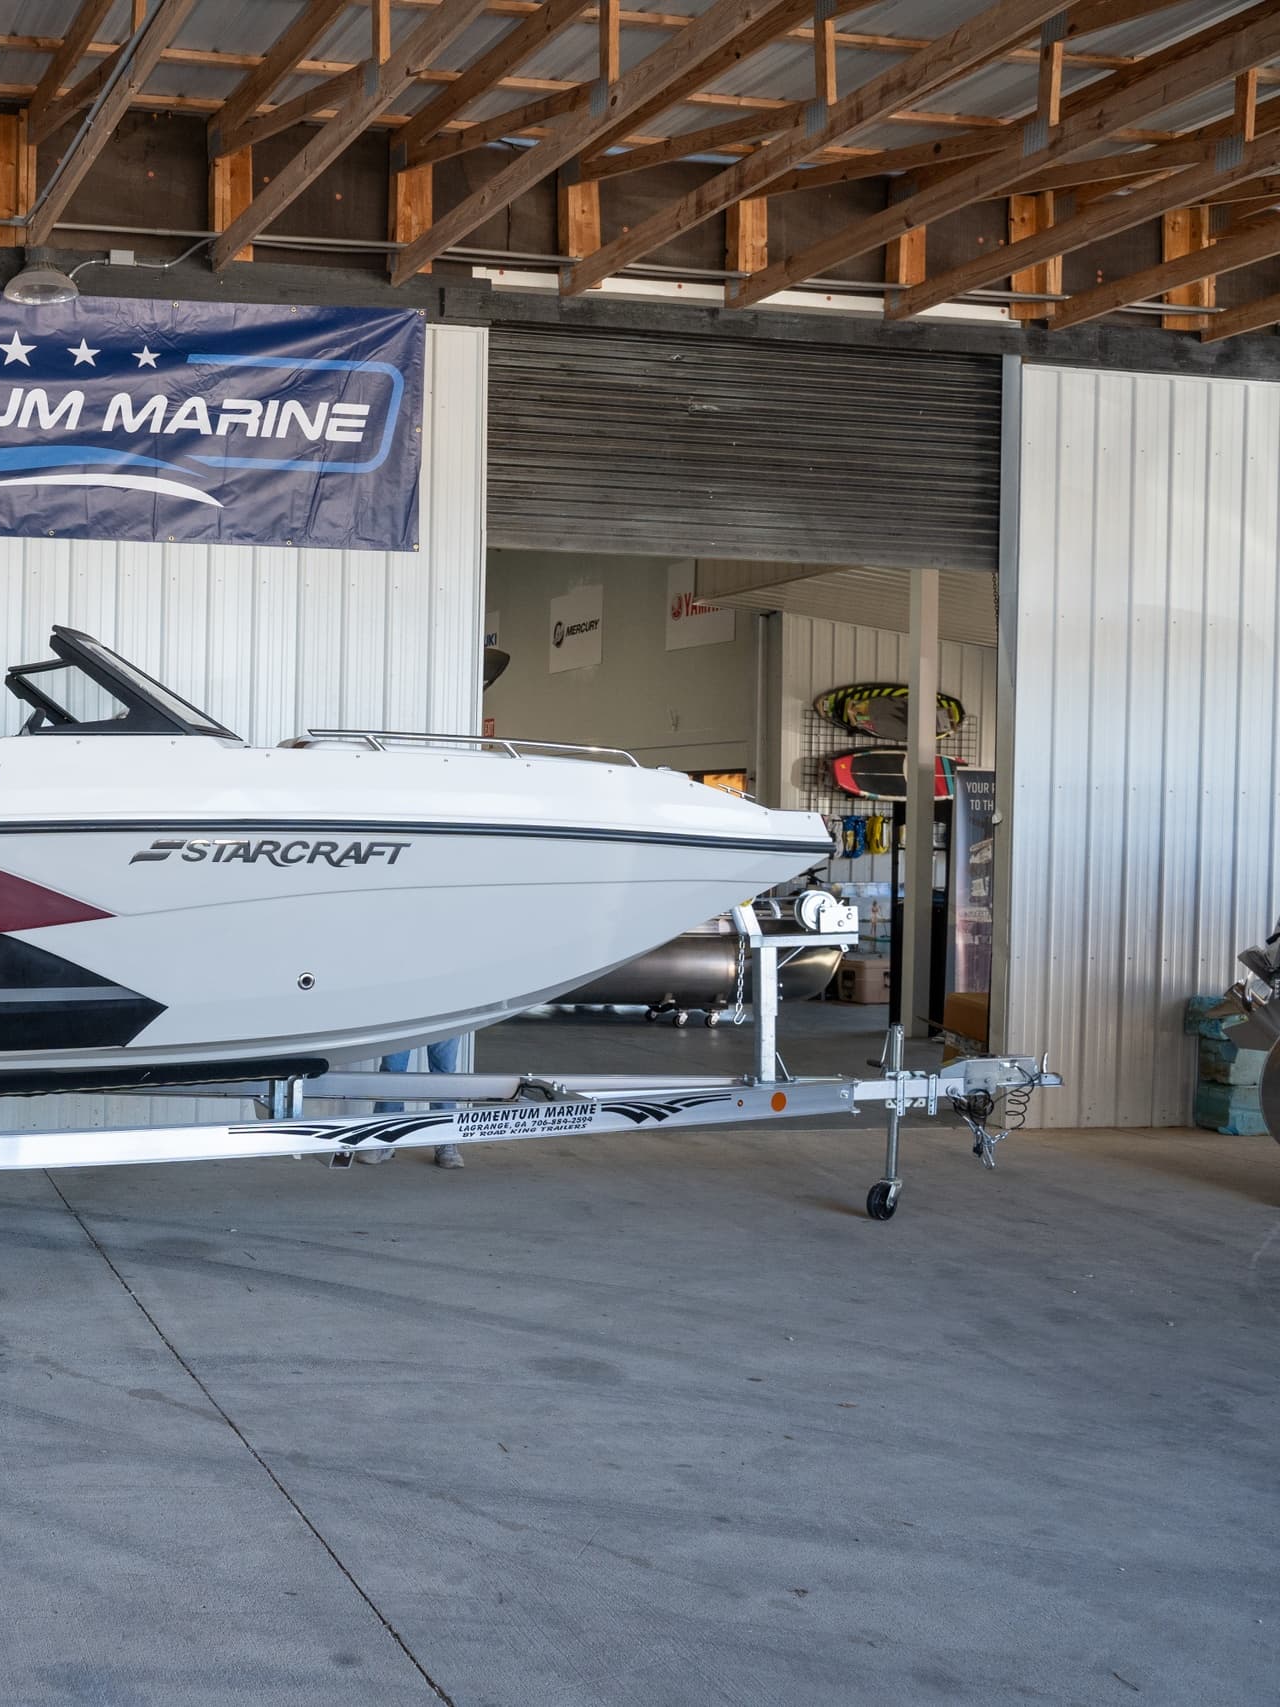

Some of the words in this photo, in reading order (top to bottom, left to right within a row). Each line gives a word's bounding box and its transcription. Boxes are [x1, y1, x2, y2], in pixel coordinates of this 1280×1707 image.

[102, 393, 368, 443] MARINE
[565, 619, 600, 637] MERCURY
[484, 632, 497, 647] UKI
[966, 782, 989, 794] YOUR
[970, 799, 980, 811] TO
[982, 800, 994, 811] TH
[181, 839, 413, 868] STARCRAFT
[457, 1108, 540, 1124] MOMENTUM
[544, 1103, 597, 1118] MARINE
[459, 1121, 513, 1132] LAGRANGE,
[514, 1120, 527, 1128] GA
[541, 1124, 588, 1132] TRAILERS
